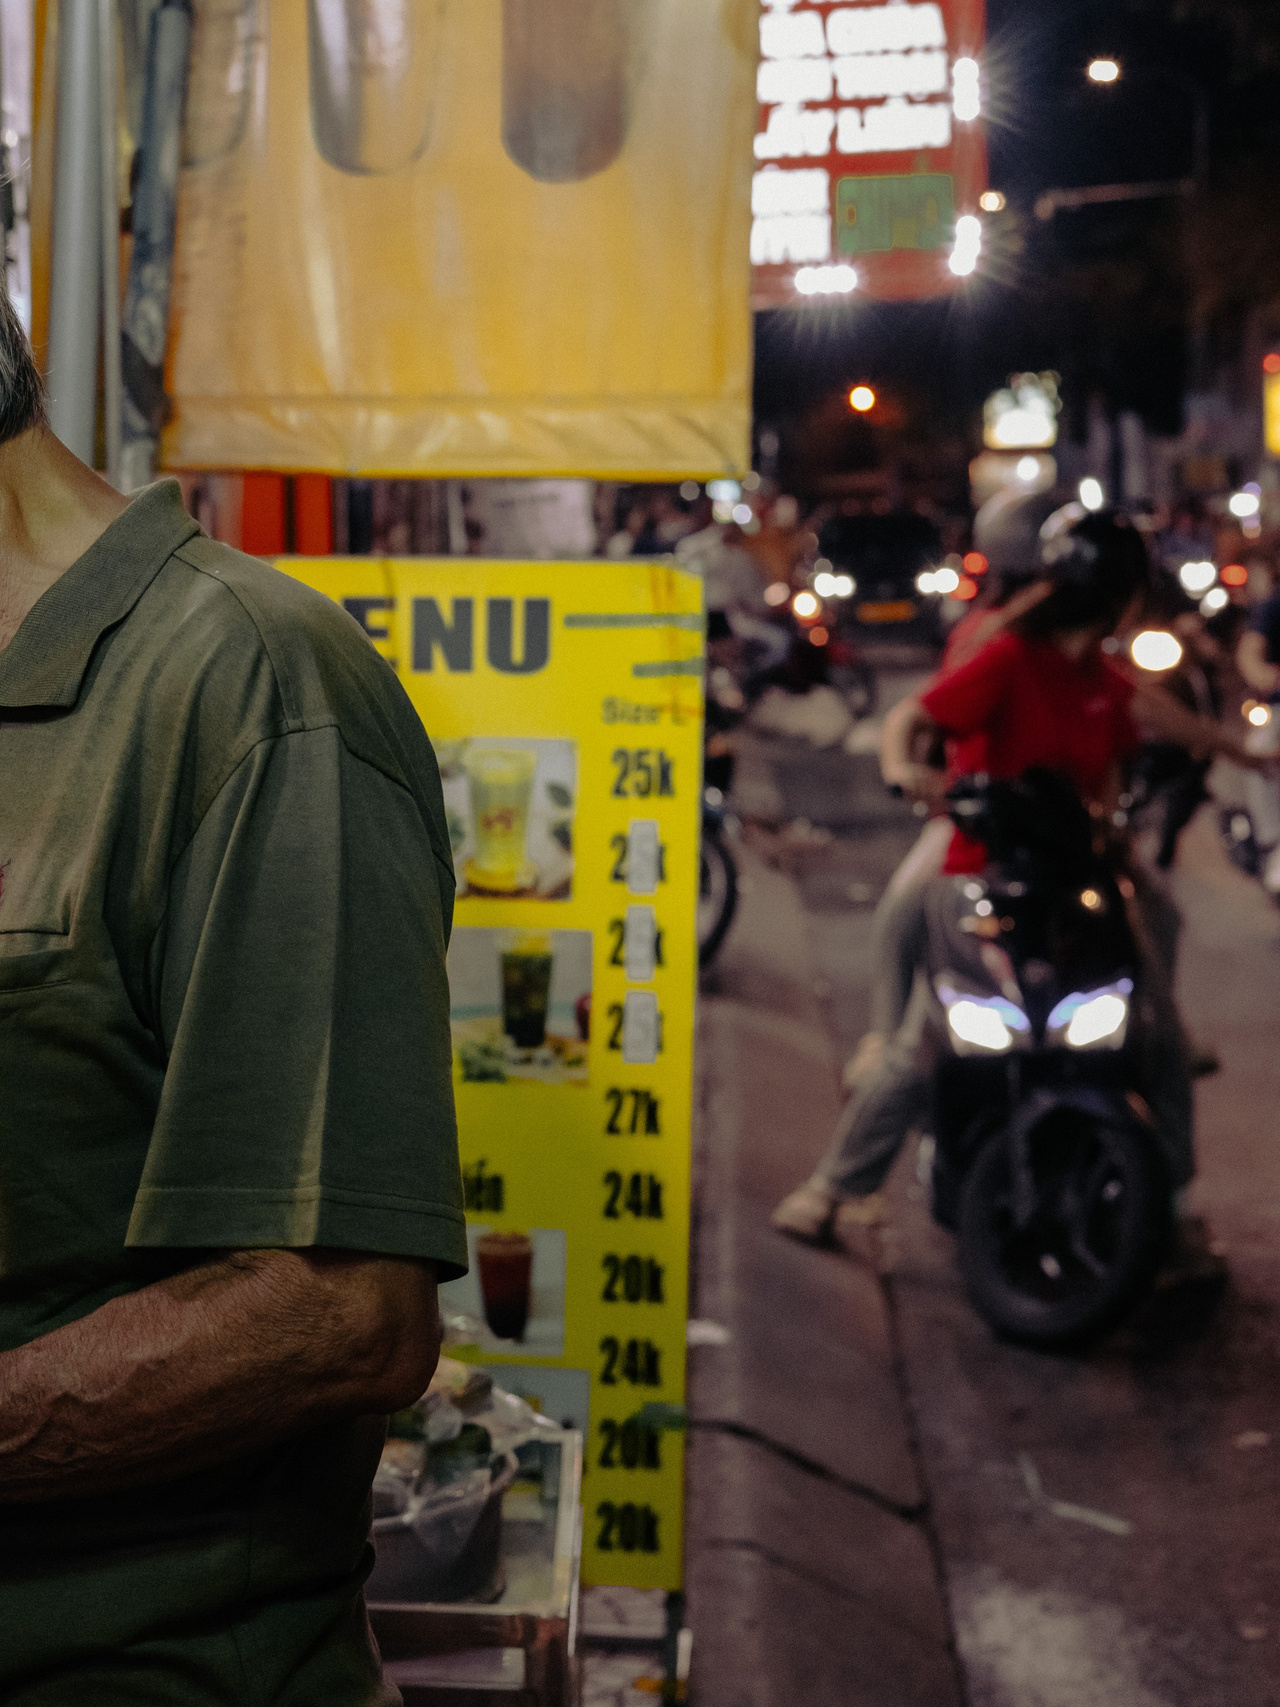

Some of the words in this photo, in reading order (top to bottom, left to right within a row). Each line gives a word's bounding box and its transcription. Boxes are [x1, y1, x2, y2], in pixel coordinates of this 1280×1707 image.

[342, 596, 550, 675] ENU
[611, 747, 674, 798] 25k
[605, 1086, 660, 1135] 27k
[604, 1169, 664, 1220] 24k
[602, 1253, 664, 1304] 20k
[600, 1335, 662, 1387] 24k
[597, 1500, 660, 1555] 20k
